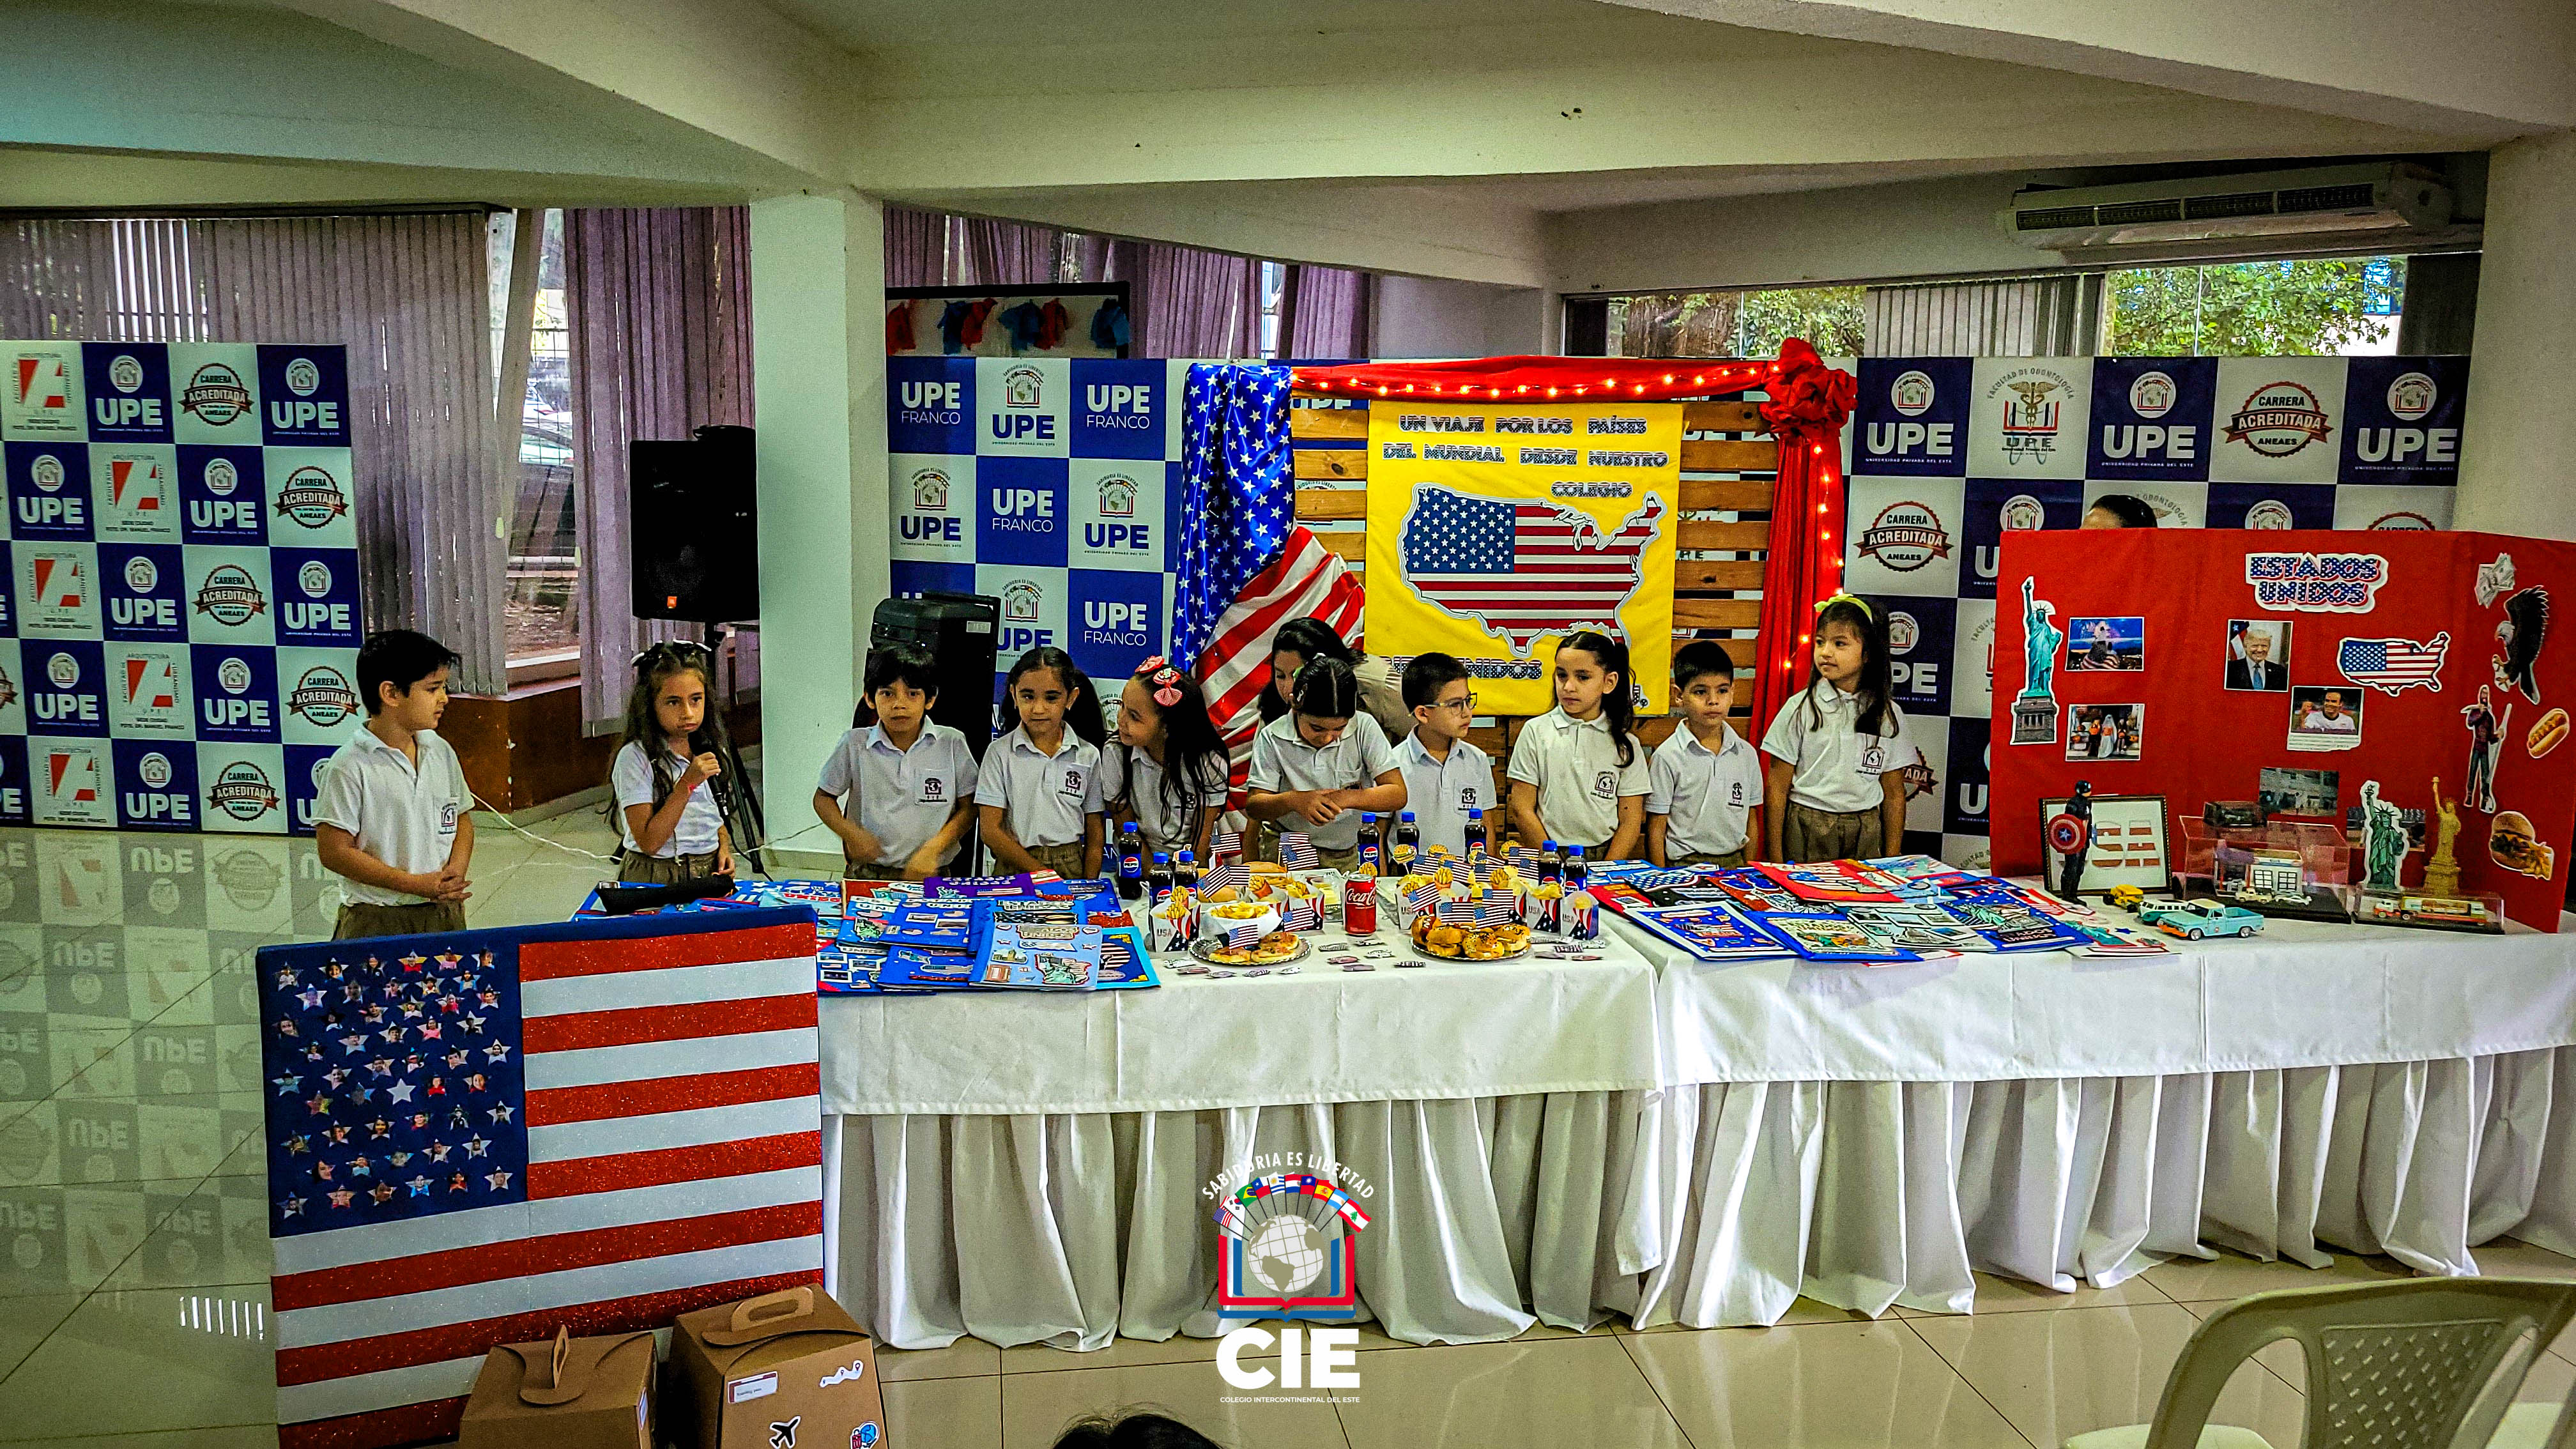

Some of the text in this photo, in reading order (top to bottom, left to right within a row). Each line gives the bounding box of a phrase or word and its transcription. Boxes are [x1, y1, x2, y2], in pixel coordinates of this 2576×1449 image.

[200, 375, 231, 383] CARRERA
[189, 389, 245, 402] ACREDITADA
[901, 382, 960, 410] UPE
[1087, 384, 1150, 413] UPE
[2258, 396, 2304, 406] CARRERA
[95, 398, 162, 425] UPE
[271, 402, 339, 428] UPE
[901, 411, 960, 425] FRANCO
[1087, 415, 1149, 429] FRANCO
[2238, 413, 2321, 430] ACREDITADA
[992, 413, 1055, 440] UPE
[1400, 415, 1426, 431] UN
[1431, 416, 1485, 432] VIAJE
[1496, 417, 1534, 433] POR
[1538, 418, 1572, 434] LOS
[1867, 422, 1953, 455] UPE
[2103, 425, 2196, 459] UPE
[2357, 427, 2458, 462] UPE
[1383, 443, 1668, 467] DEL MUNDIAL DESDE NUESTRO
[295, 478, 327, 487] CARRERA
[1551, 481, 1632, 497] COLEGIO
[17, 496, 84, 524] UPE
[284, 492, 341, 506] ACREDITADA
[993, 488, 1054, 518] UPE
[190, 500, 257, 528] UPE
[992, 518, 1053, 532] FRANCO
[1887, 514, 1928, 525] CARRERA
[901, 515, 961, 541] UPE
[1085, 523, 1149, 549] UPE
[1869, 531, 1943, 546] ACREDITADA
[214, 576, 245, 585] CARRERA
[2250, 556, 2381, 582] ESTADOS
[203, 590, 260, 603] ACREDITADA
[2258, 581, 2368, 606] UNIDOS
[111, 598, 178, 625] UPE
[284, 602, 351, 630] UPE
[1085, 601, 1147, 631] UPE
[1084, 631, 1146, 647] FRANCO
[308, 677, 339, 686] CARRERA
[1892, 661, 1938, 694] PE
[34, 693, 99, 720] UPE
[296, 691, 352, 704] ACREDITADA
[204, 698, 270, 726] UPE
[227, 772, 259, 781] CARRERA
[217, 786, 273, 799] ACREDITADA
[126, 793, 191, 820] UPE
[1528, 905, 1540, 915] USA
[1562, 913, 1575, 924] USA
